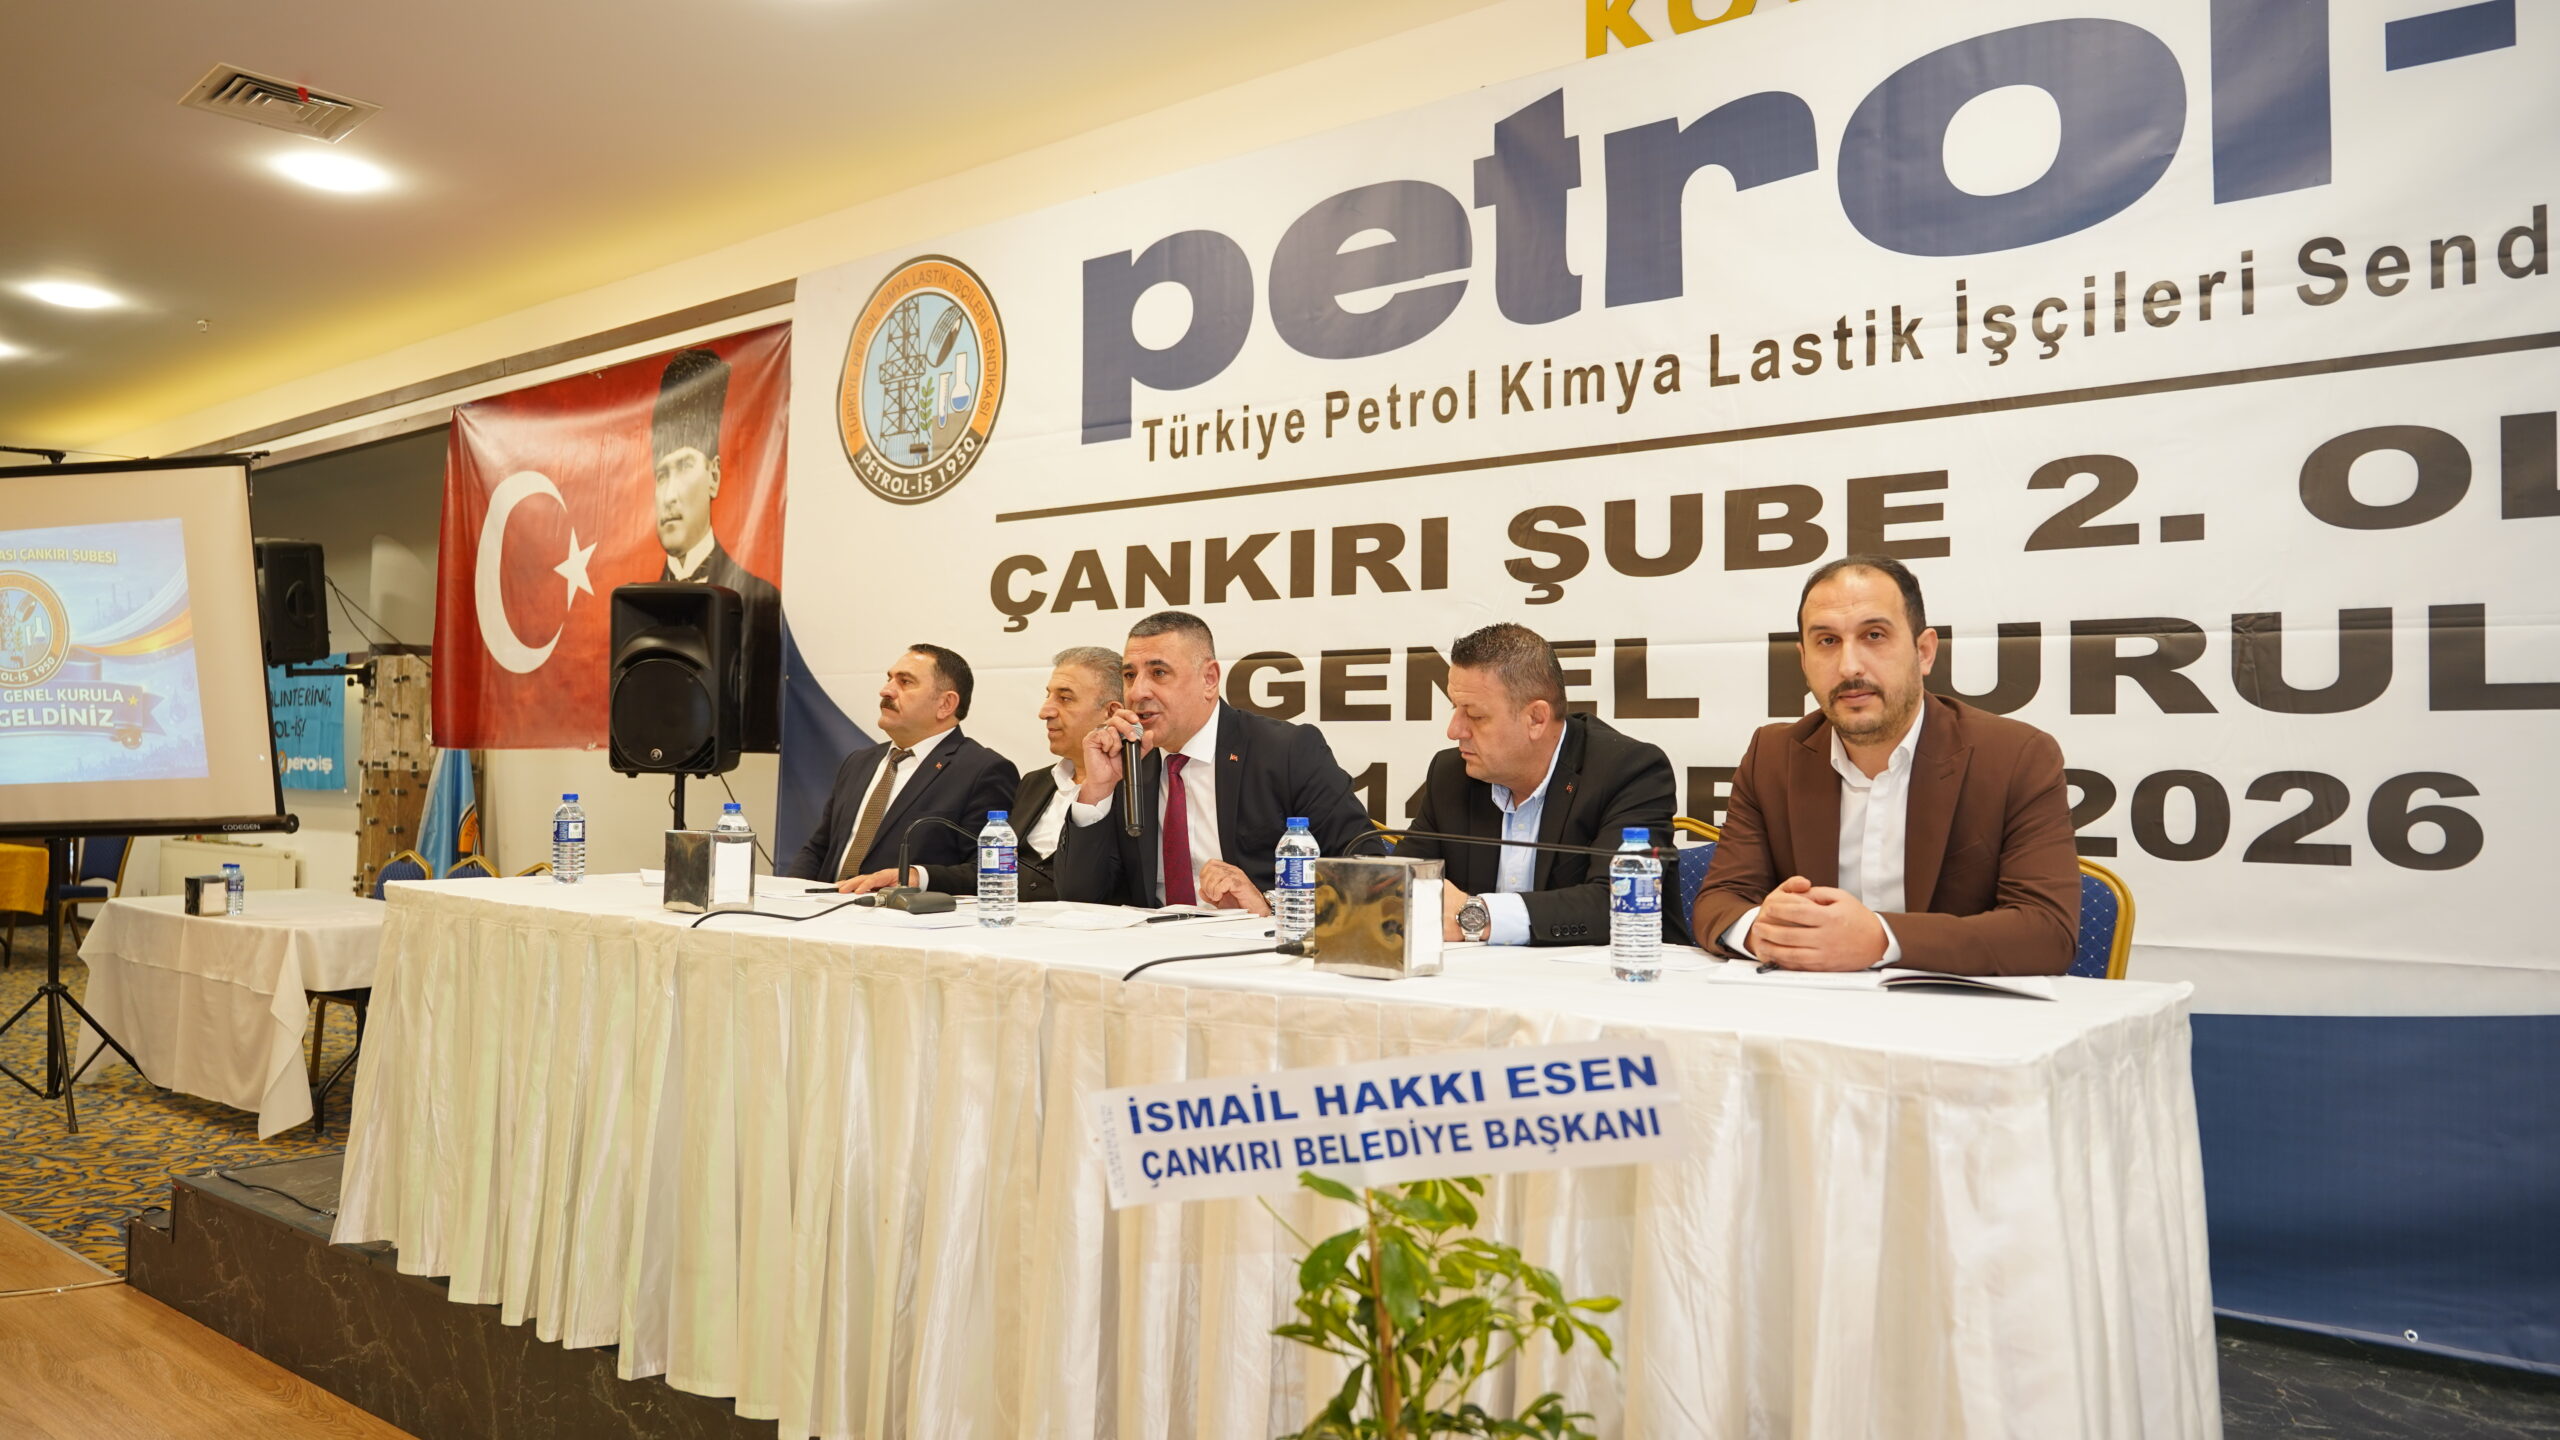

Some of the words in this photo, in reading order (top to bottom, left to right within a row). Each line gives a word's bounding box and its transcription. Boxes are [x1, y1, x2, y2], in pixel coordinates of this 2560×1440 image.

[911, 268, 951, 287] LASTİK
[1142, 407, 1305, 462] Türkiye
[1325, 369, 1476, 439] Petrol
[1501, 357, 1681, 415] Kimya
[1709, 304, 1924, 388] Lastik
[1956, 249, 2255, 367] İşçileri
[2296, 203, 2549, 307] Send
[859, 451, 934, 495] PETROL-İŞ
[938, 436, 976, 483] 1950
[20, 548, 69, 562] ÇANKIRI
[71, 547, 118, 565] ŞUBESİ
[990, 516, 1449, 633] ÇANKIRI
[1503, 469, 1952, 606] ŞUBE
[2023, 454, 2205, 553] 2.
[0, 670, 29, 683] OL-İŞ
[32, 656, 56, 677] 1950
[3, 688, 54, 703] GENEL
[56, 687, 125, 703] KURULA
[0, 704, 115, 728] GELDİNİZ
[274, 715, 308, 740] OL-İŞ!
[1128, 1083, 1299, 1135] İSMAİL
[1314, 1070, 1486, 1117] HAKKI
[1505, 1055, 1658, 1099] ESEN
[1141, 1139, 1282, 1188] ÇANKIRI
[1293, 1117, 1473, 1167] BELEDİYE
[1483, 1107, 1661, 1157] BAŞKANI
